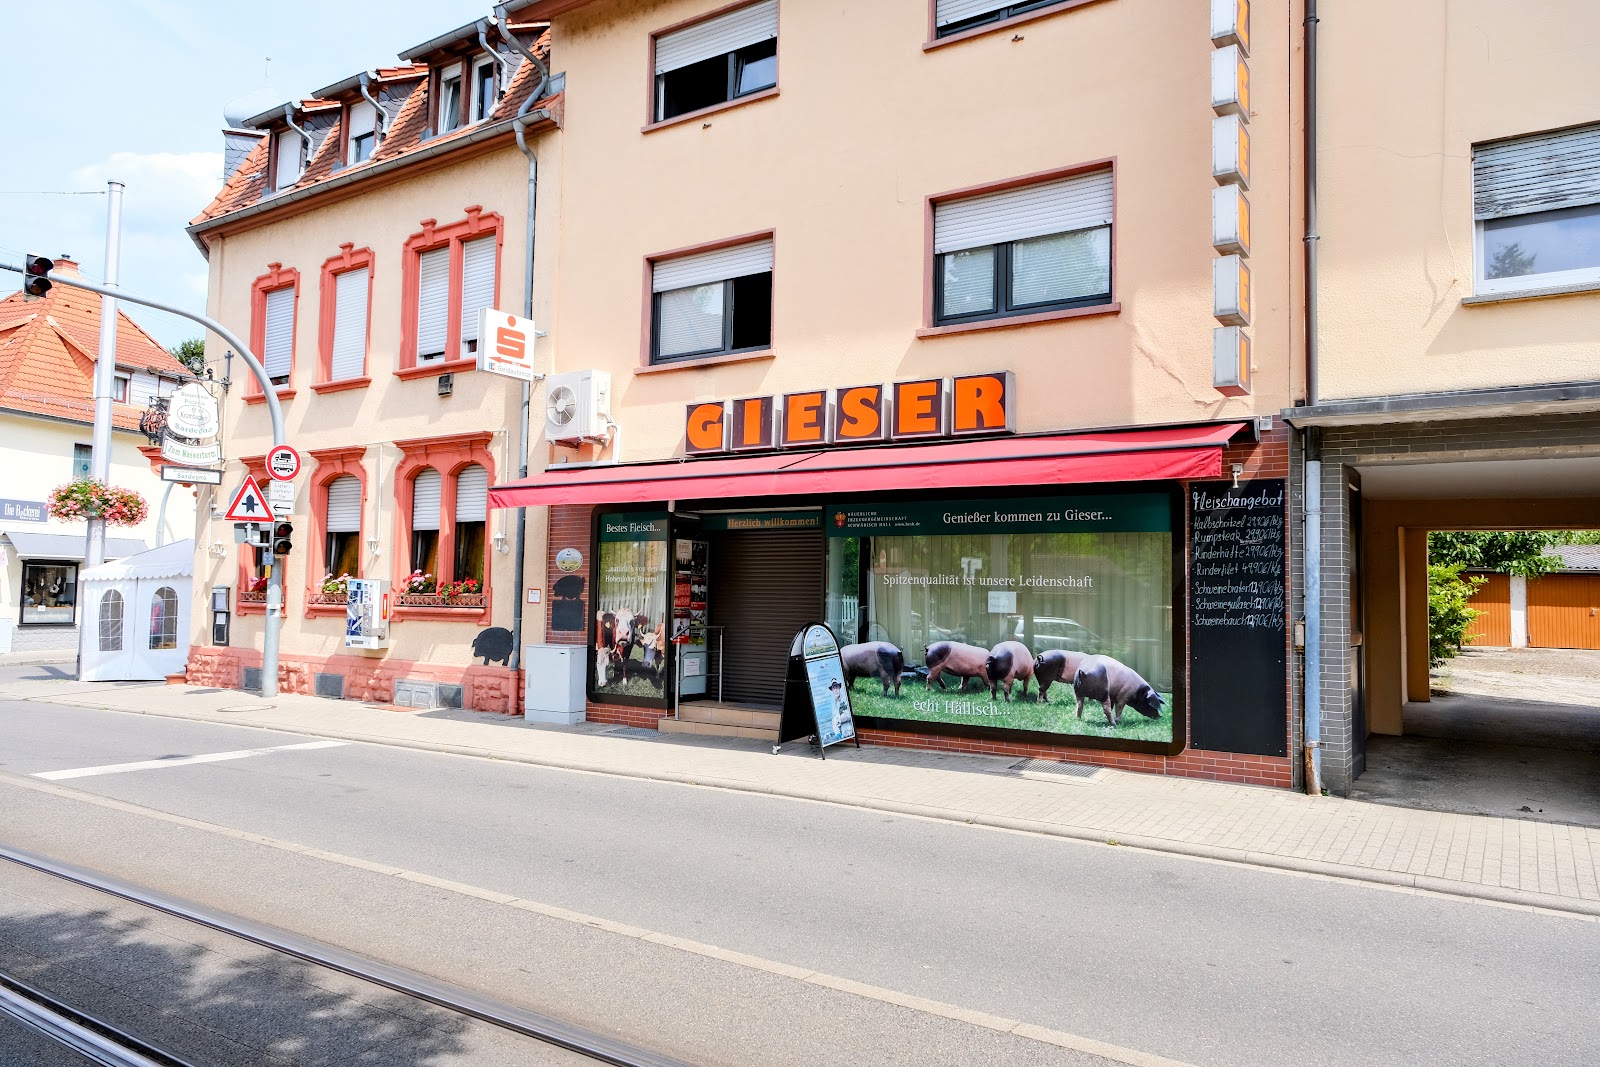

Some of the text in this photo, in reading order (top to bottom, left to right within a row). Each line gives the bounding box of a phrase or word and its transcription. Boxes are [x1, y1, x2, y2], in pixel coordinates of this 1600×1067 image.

[687, 376, 1005, 449] GIESER
[174, 422, 213, 434] Sardegna
[168, 445, 181, 456] Zum
[1192, 489, 1283, 511] Fleischangebot
[4, 503, 15, 516] Die
[727, 516, 819, 527] Herzlich willkommen!
[943, 509, 1113, 524] Genießer kommen zu Gieser...
[606, 522, 661, 533] Bestes Fleisch...
[883, 574, 1094, 588] Spitzenqualität ist unsere Leidenschaft
[913, 698, 1011, 716] echt Hällisch...
